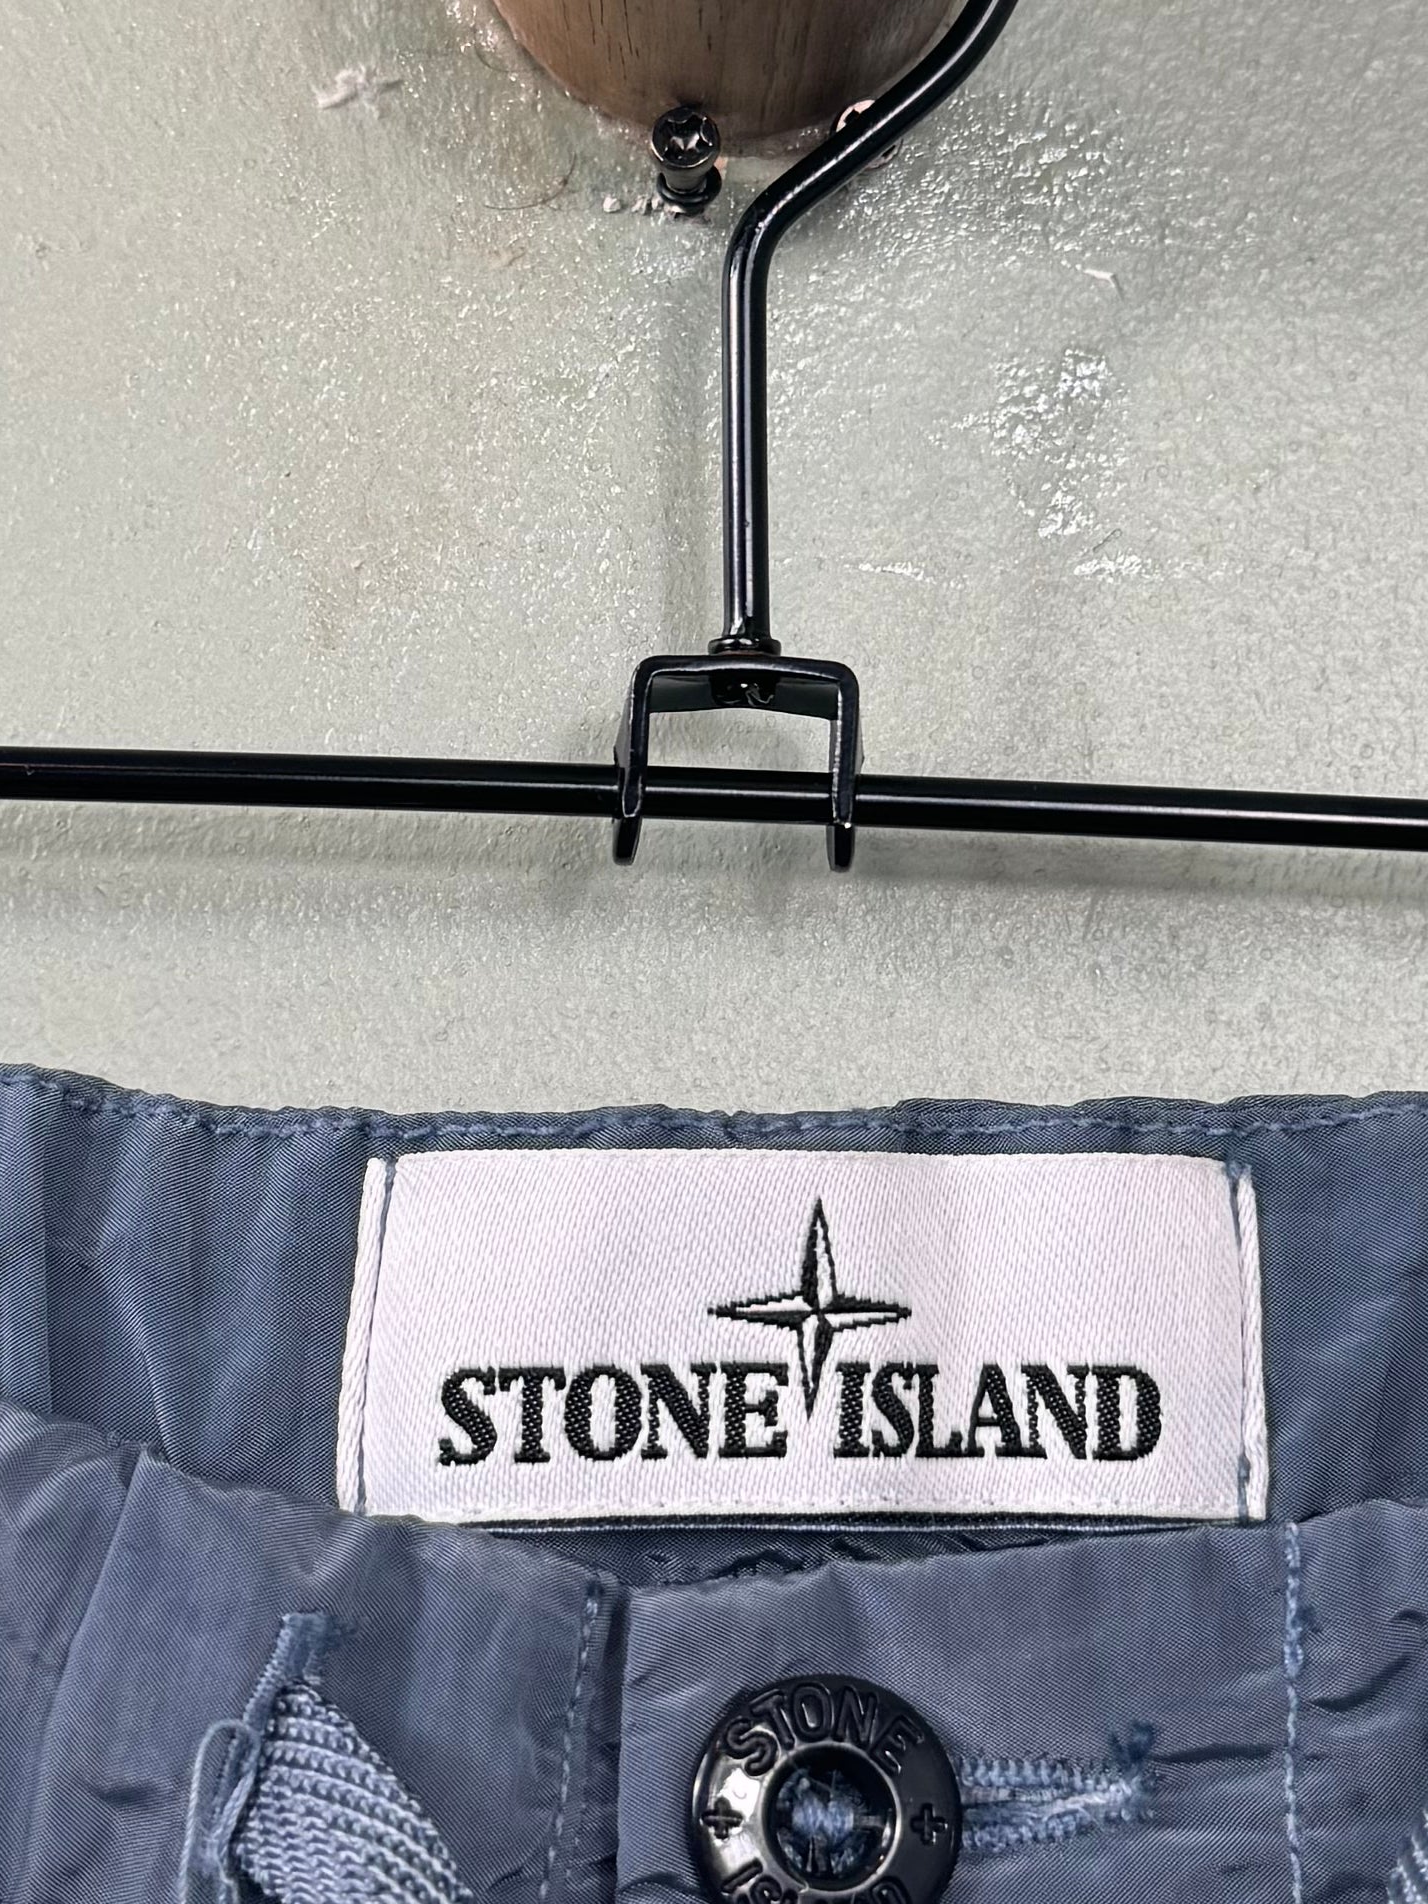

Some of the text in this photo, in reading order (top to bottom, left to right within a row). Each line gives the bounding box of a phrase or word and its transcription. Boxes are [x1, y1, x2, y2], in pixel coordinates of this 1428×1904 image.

[435, 1360, 1162, 1466] STONE ISLAND
[725, 1681, 924, 1777] STONE
